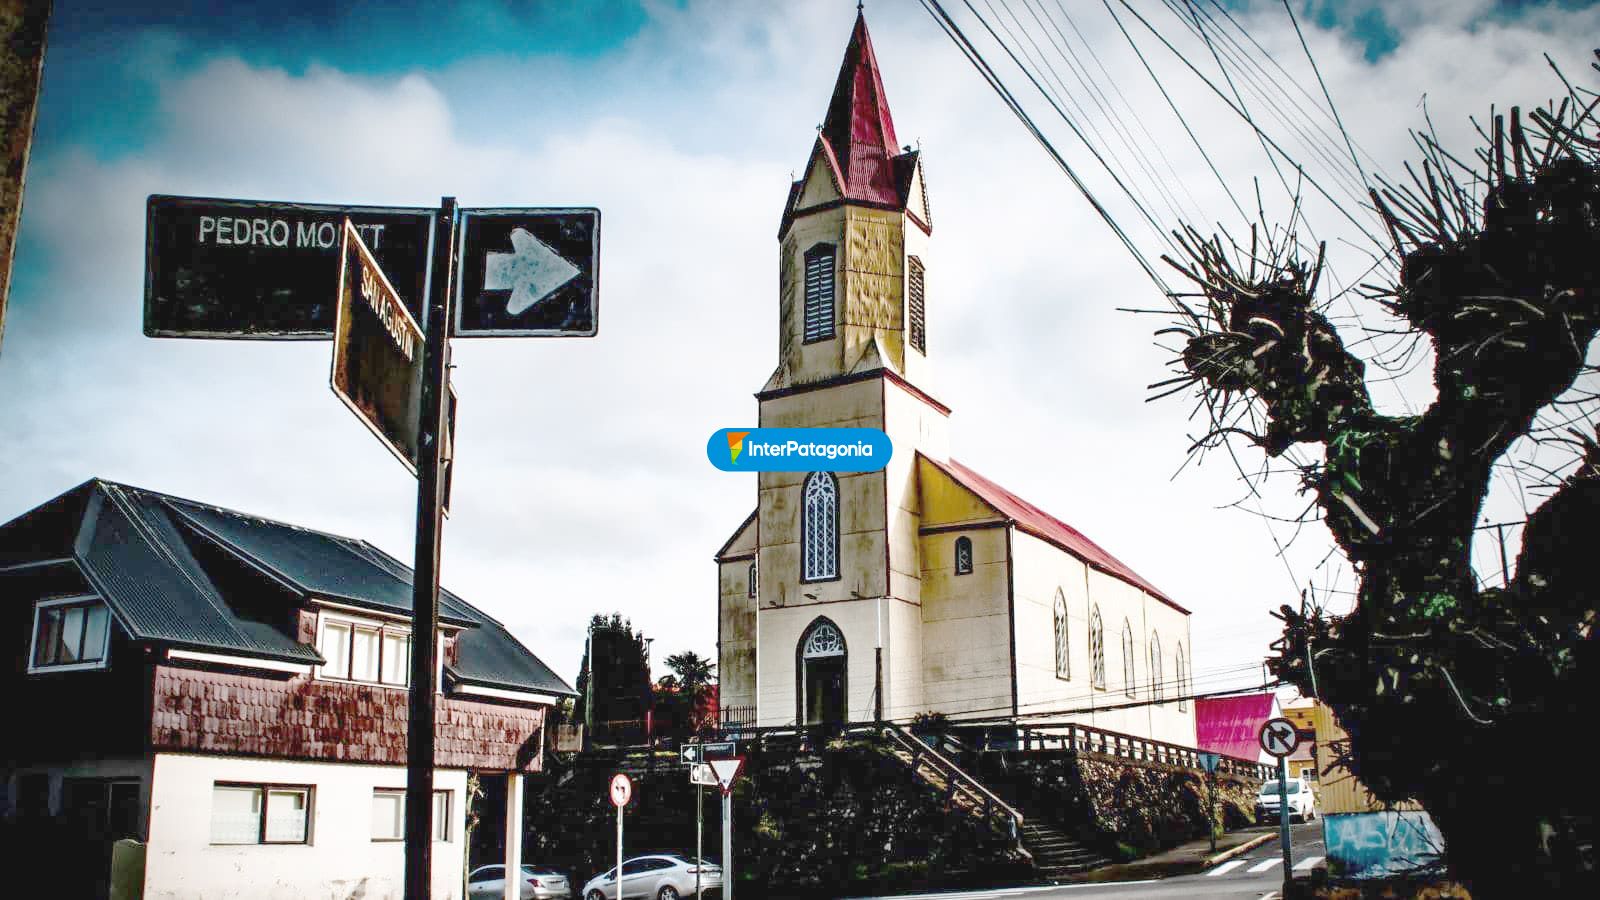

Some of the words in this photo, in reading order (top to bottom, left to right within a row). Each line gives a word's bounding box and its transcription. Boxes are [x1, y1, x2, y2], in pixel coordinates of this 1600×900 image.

[199, 215, 290, 247] PEDRO
[296, 221, 385, 249] MOTT
[361, 265, 380, 315] SAN
